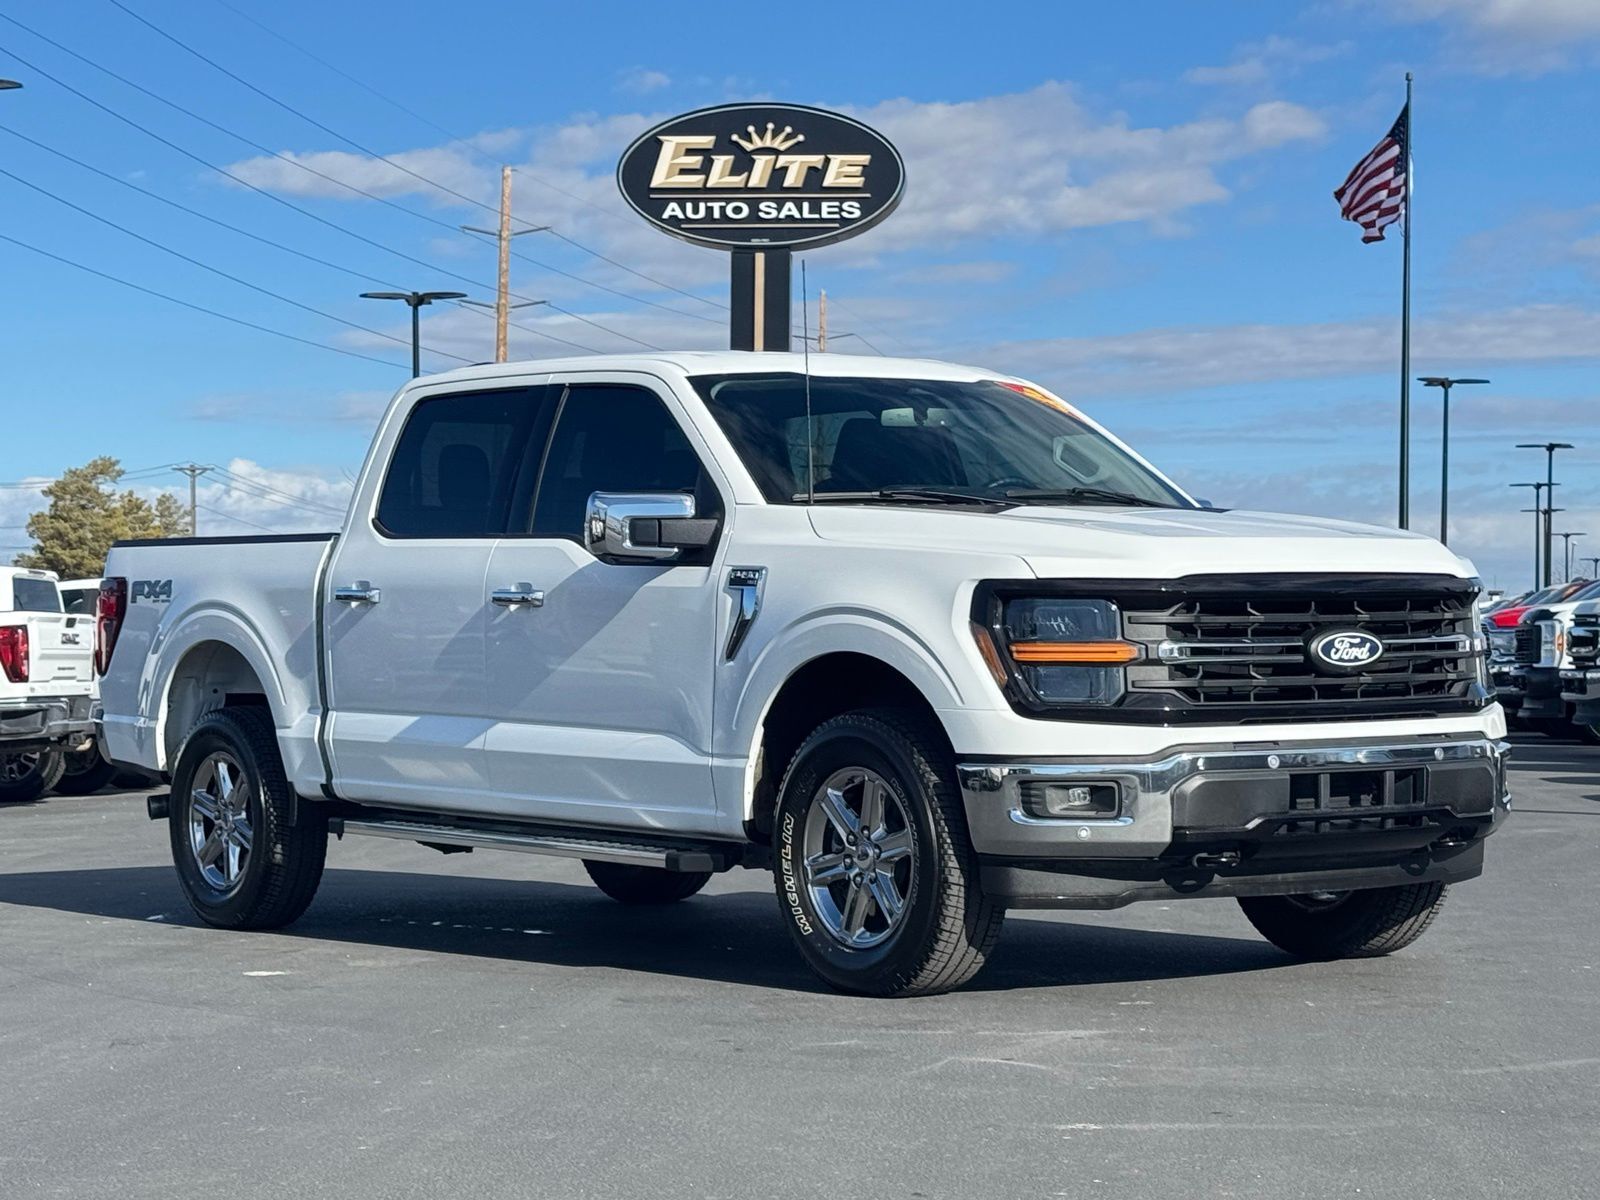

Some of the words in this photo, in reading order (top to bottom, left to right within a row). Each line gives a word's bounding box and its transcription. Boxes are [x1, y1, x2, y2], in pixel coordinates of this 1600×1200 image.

[650, 135, 872, 188] ELITE
[661, 201, 750, 219] AUTO
[757, 201, 862, 219] SALES
[130, 579, 173, 604] FX4
[1330, 636, 1371, 660] Ford
[781, 812, 813, 936] MICHELIN
